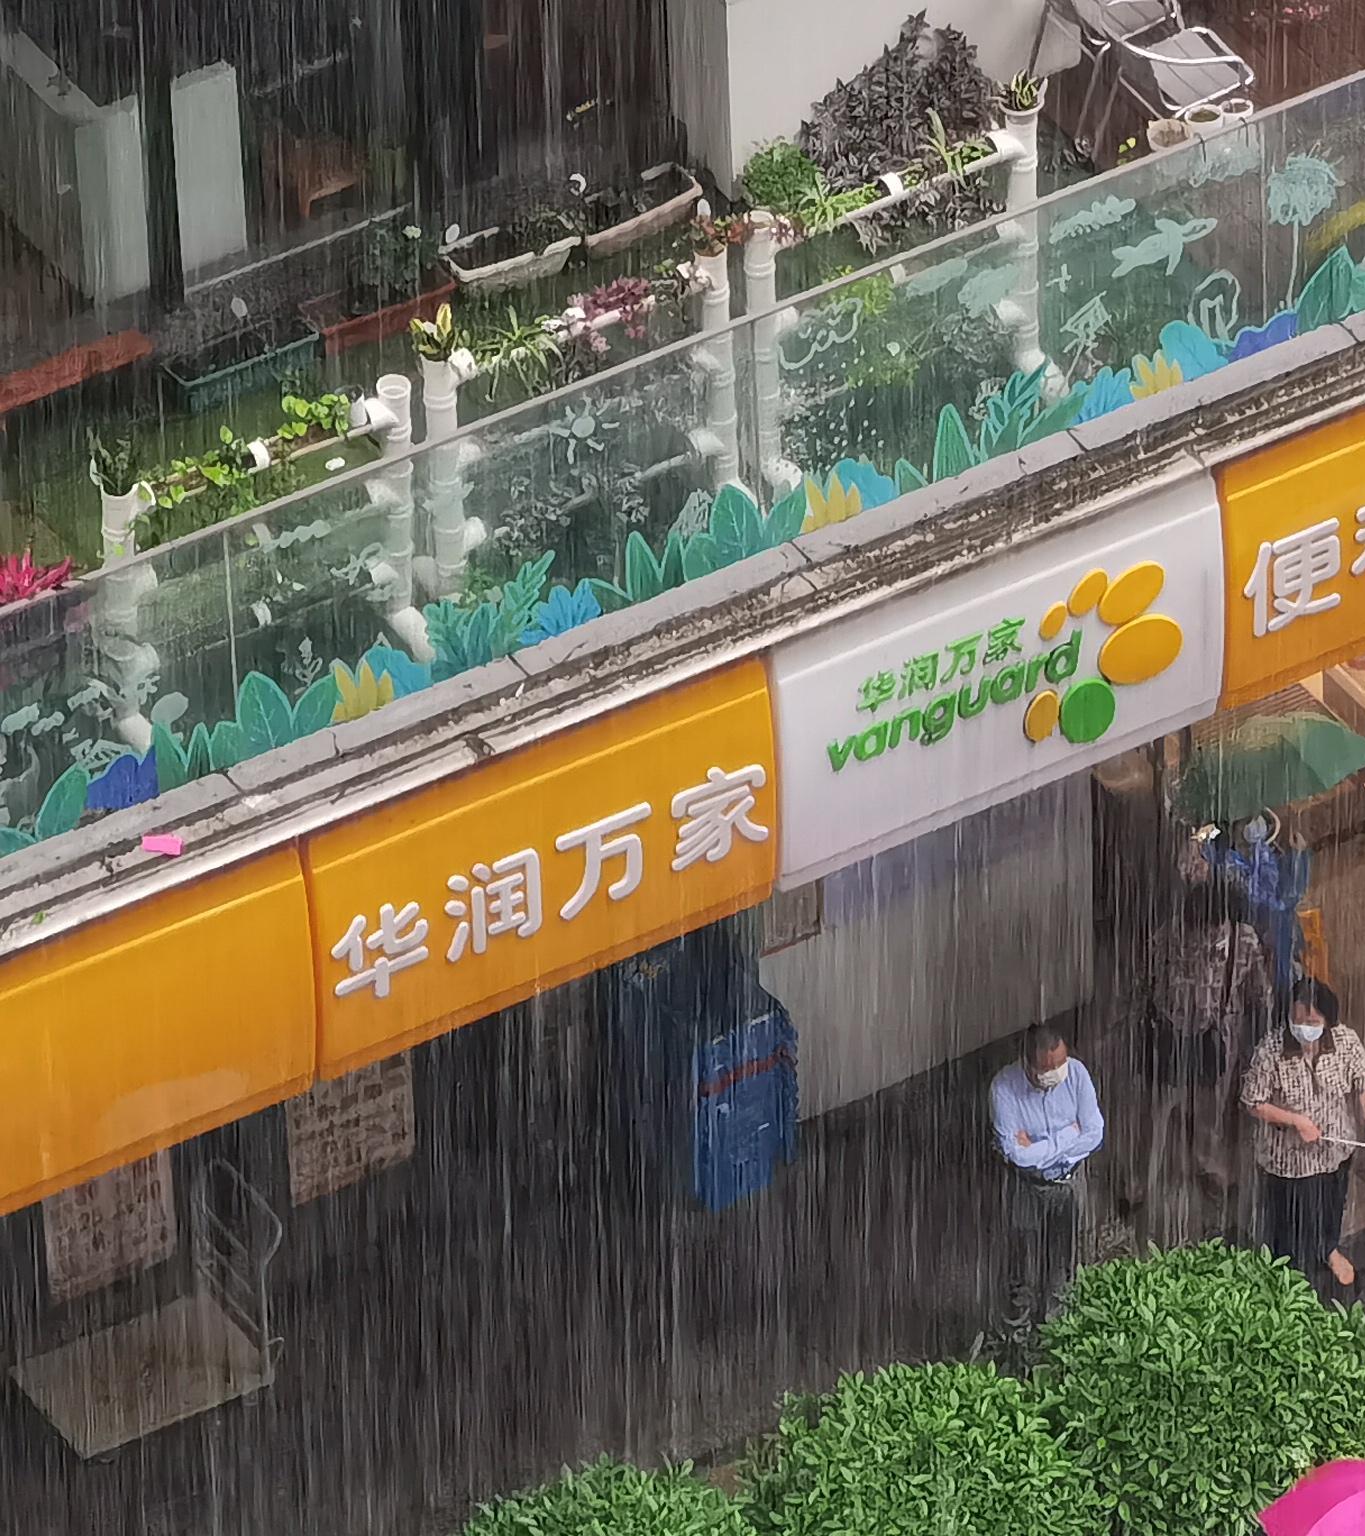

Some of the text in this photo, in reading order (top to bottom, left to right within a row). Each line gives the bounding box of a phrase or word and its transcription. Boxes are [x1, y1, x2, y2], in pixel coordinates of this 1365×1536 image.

[826, 628, 1083, 774] vanguard
[856, 616, 1026, 713] 华润万家
[331, 764, 769, 997] 华润万家
